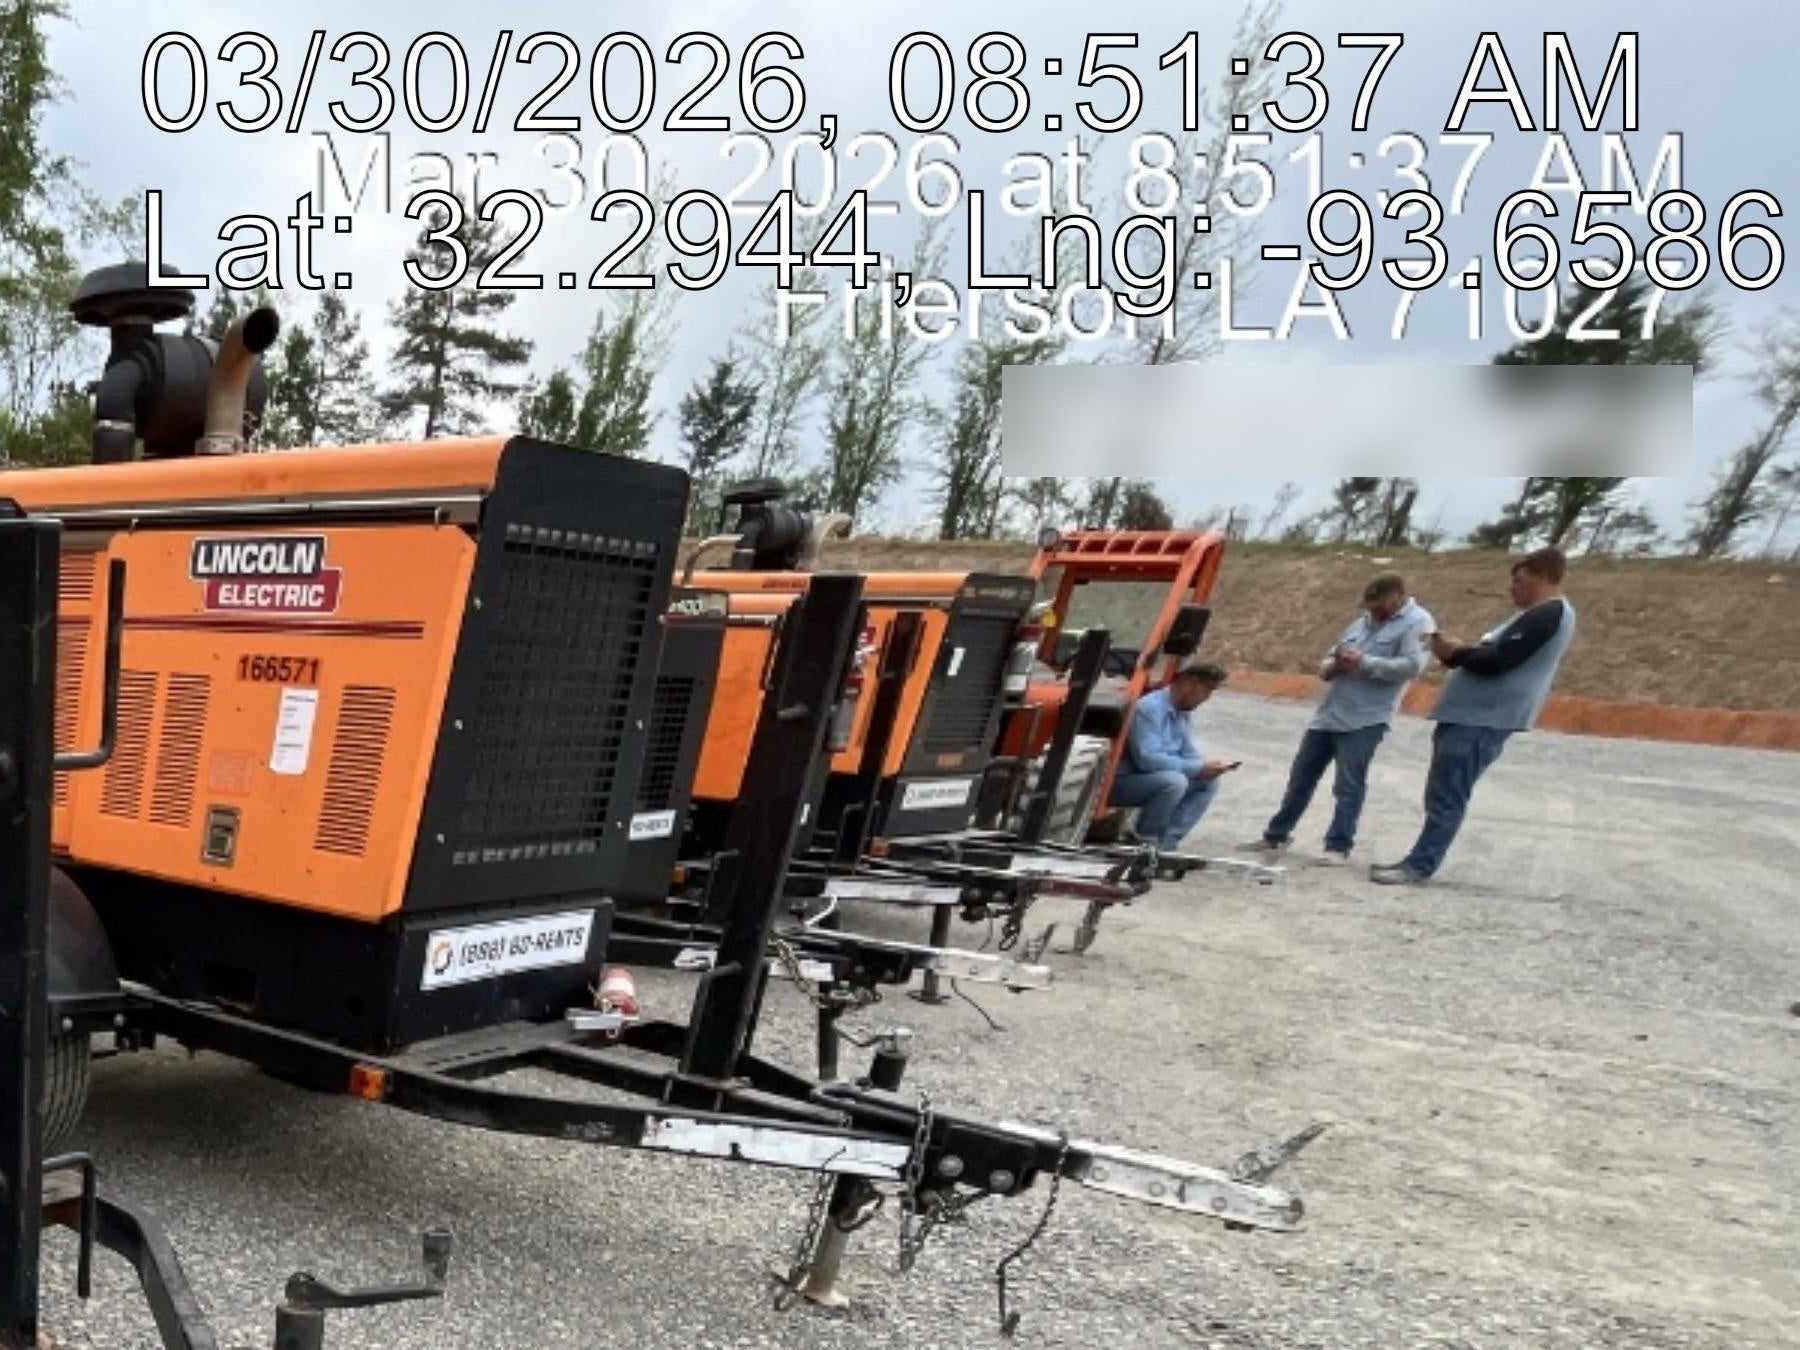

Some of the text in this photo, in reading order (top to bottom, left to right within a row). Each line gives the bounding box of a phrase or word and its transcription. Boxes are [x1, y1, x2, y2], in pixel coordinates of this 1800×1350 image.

[197, 542, 317, 574] LINCOLN
[218, 583, 326, 608] ELECTRIC
[238, 653, 321, 685] 166571
